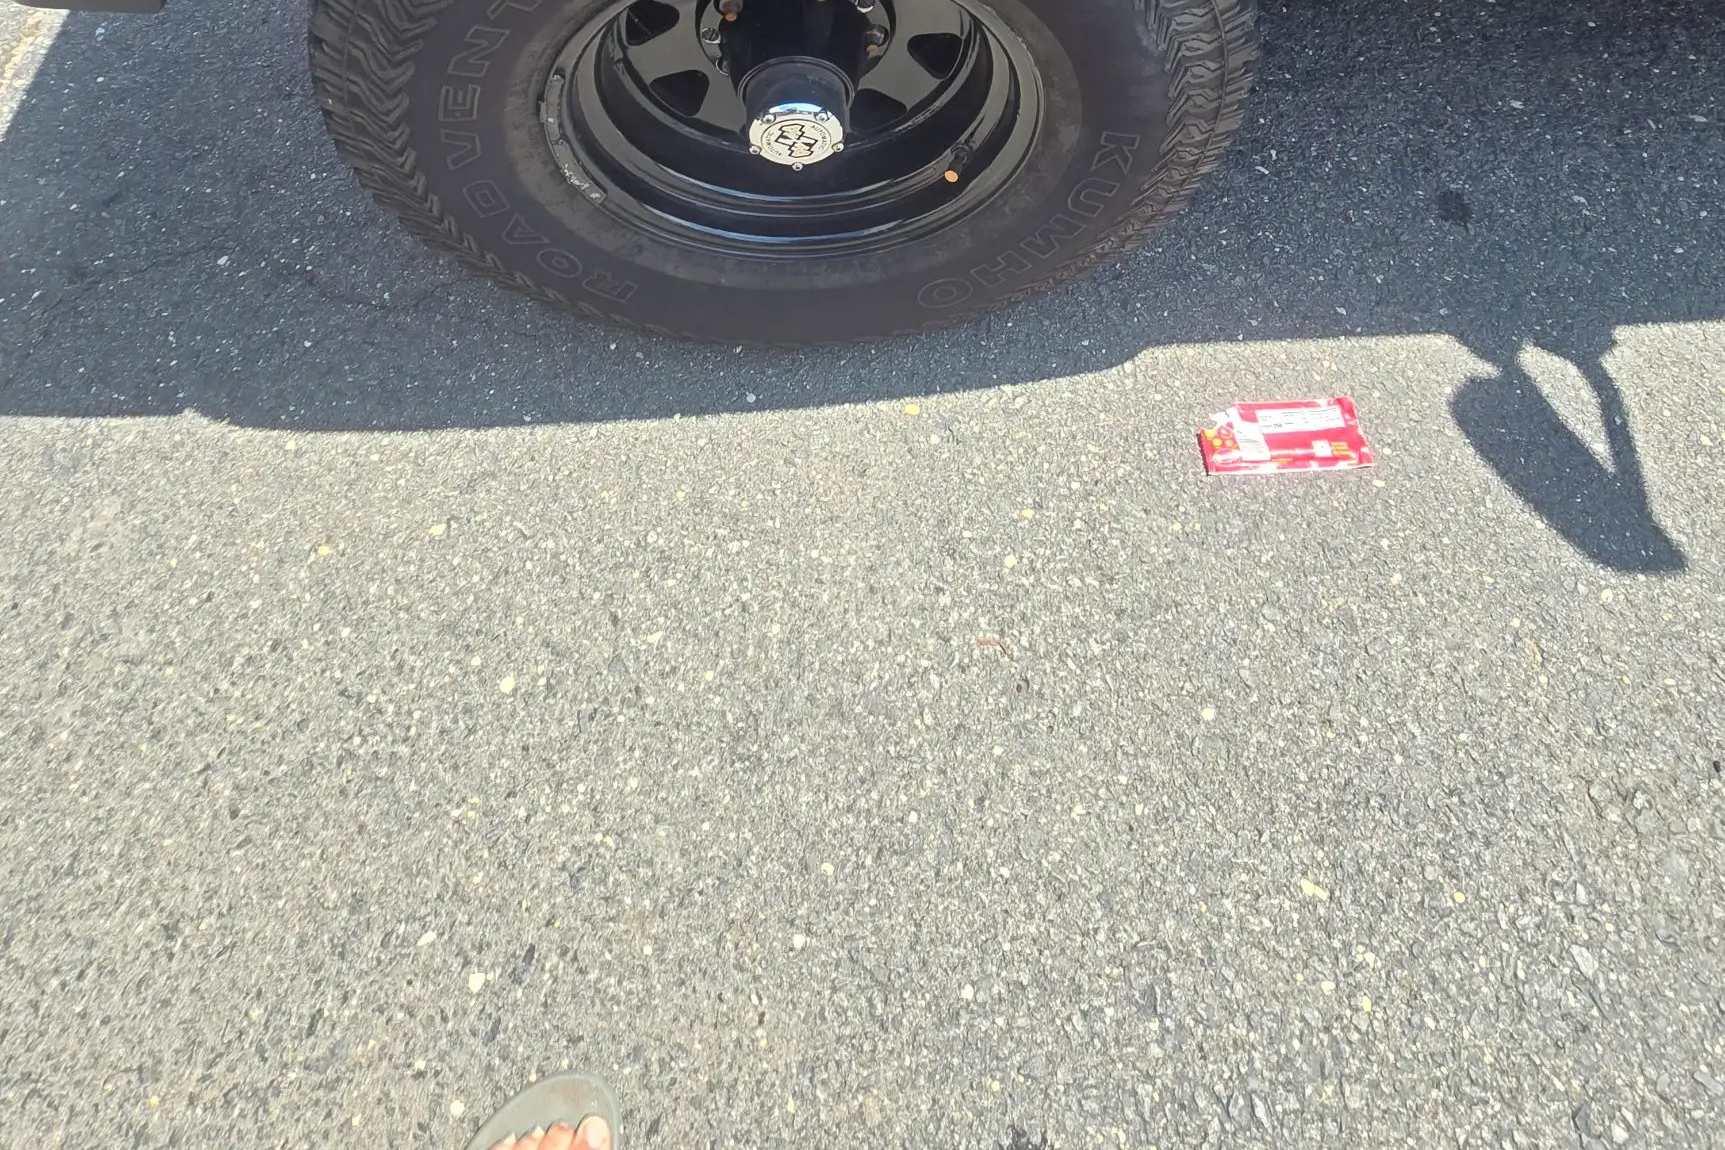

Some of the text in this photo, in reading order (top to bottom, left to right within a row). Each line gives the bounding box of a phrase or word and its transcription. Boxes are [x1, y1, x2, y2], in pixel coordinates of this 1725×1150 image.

[765, 130, 783, 157] AUTOMATIC
[810, 125, 829, 151] AUTOMATIC
[462, 179, 640, 305] ROAD
[917, 131, 1140, 308] KUMHO
